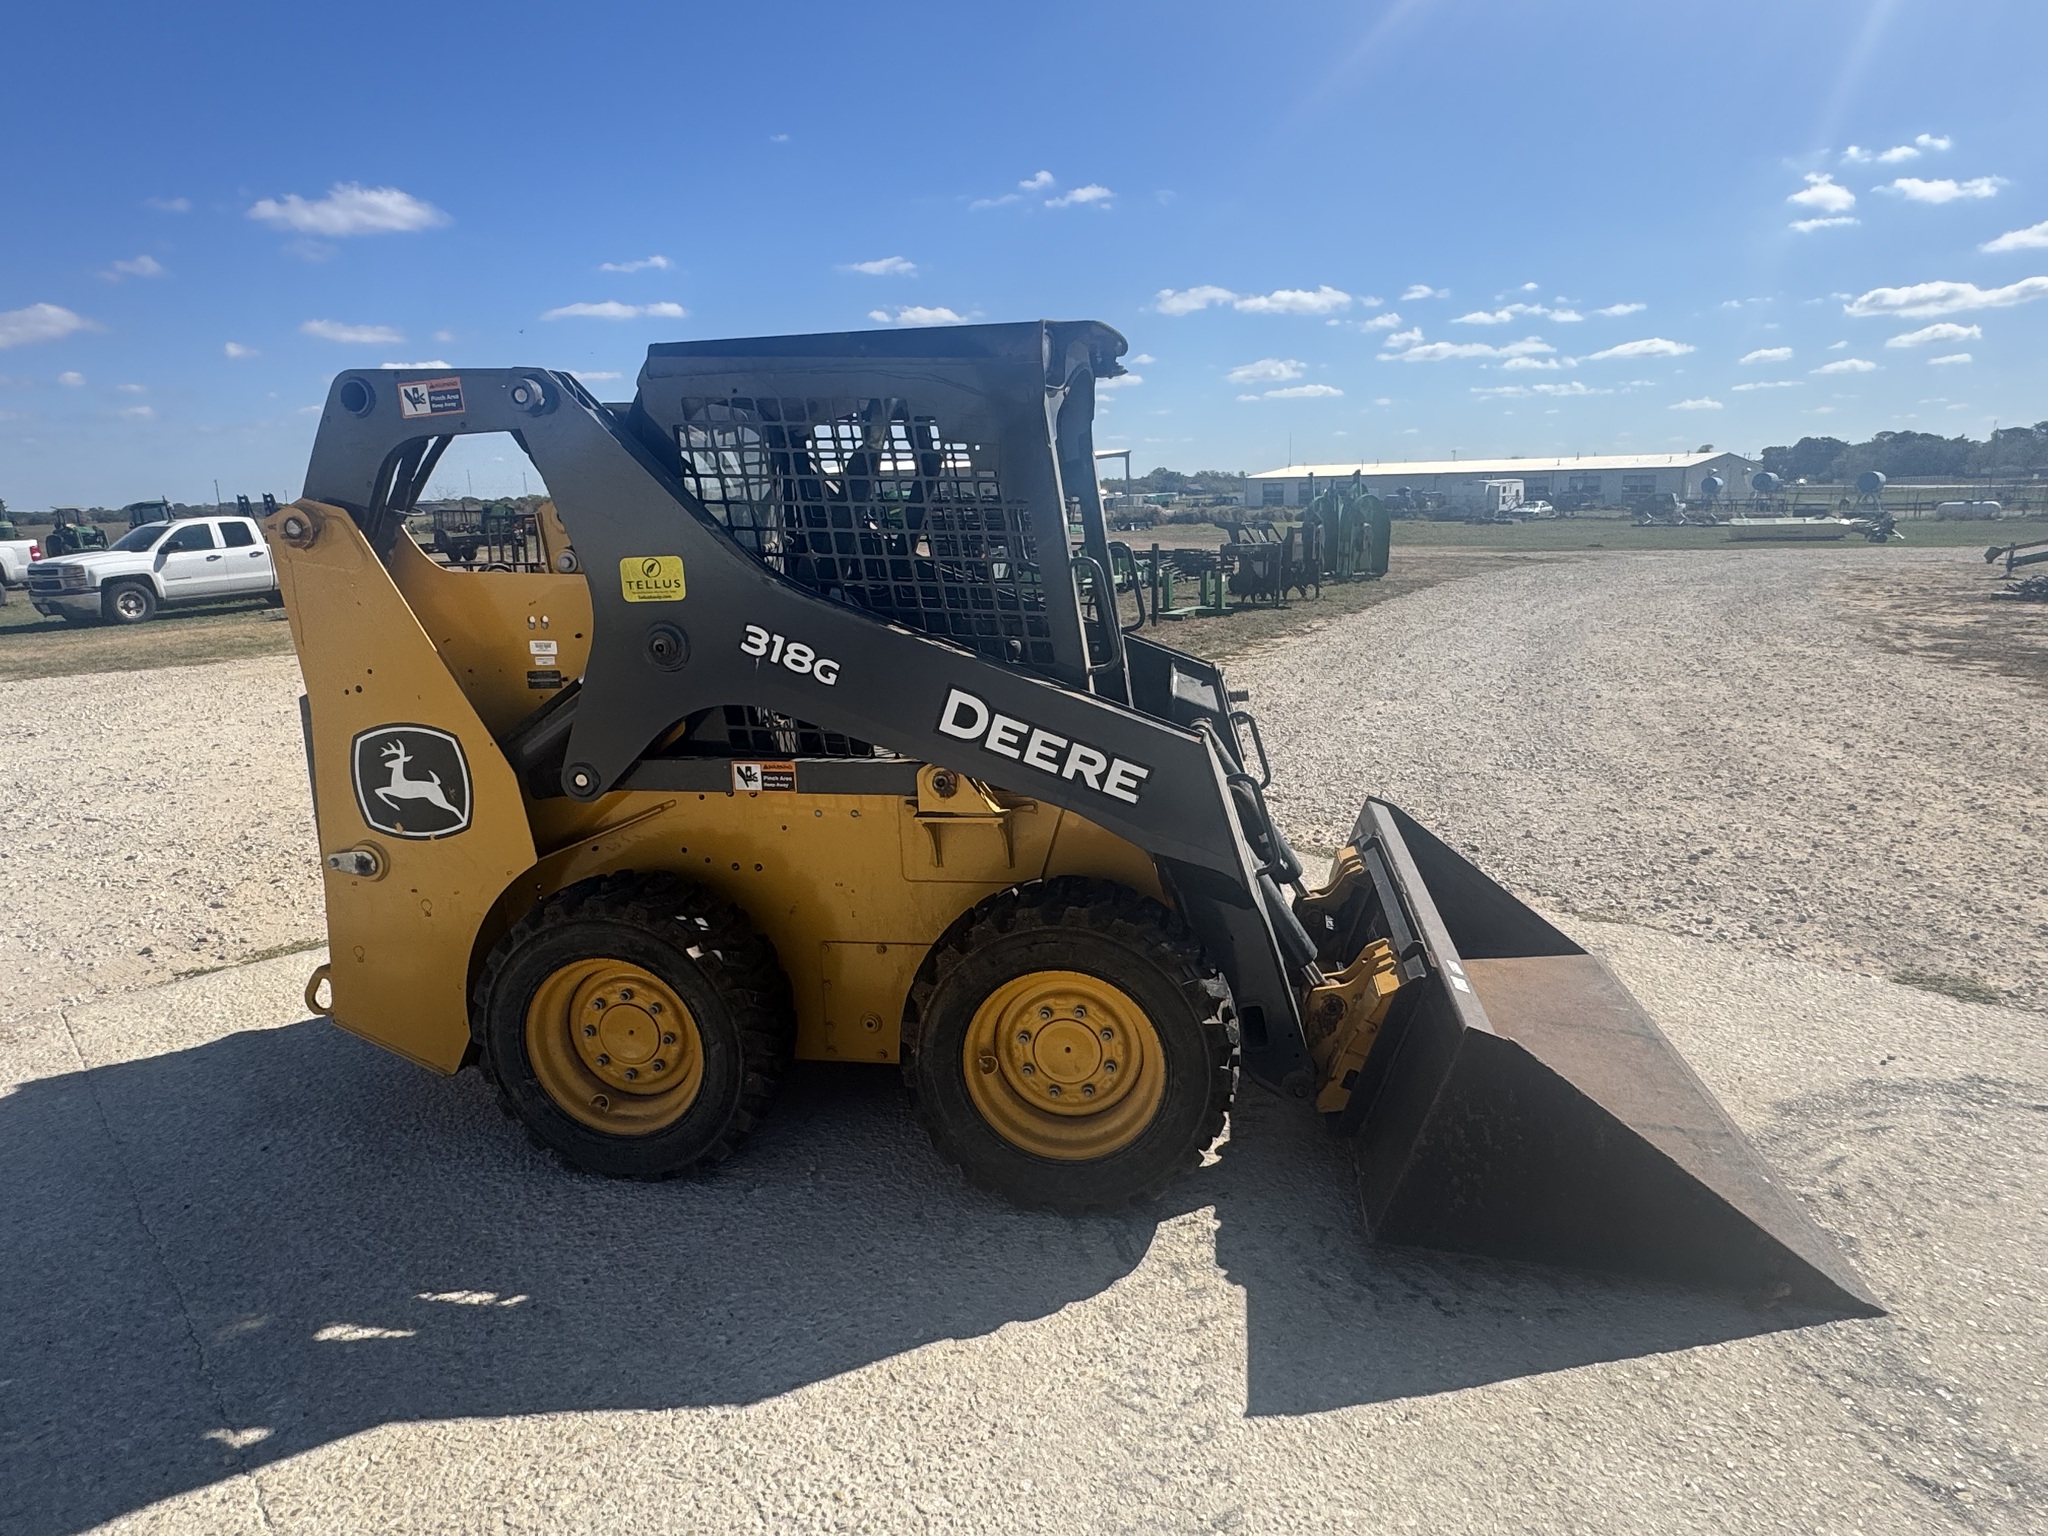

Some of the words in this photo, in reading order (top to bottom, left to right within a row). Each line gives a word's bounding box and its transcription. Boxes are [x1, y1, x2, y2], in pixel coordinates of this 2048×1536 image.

[626, 579, 681, 590] TELLUS
[740, 624, 840, 686] 318G
[939, 688, 1149, 804] DEERE
